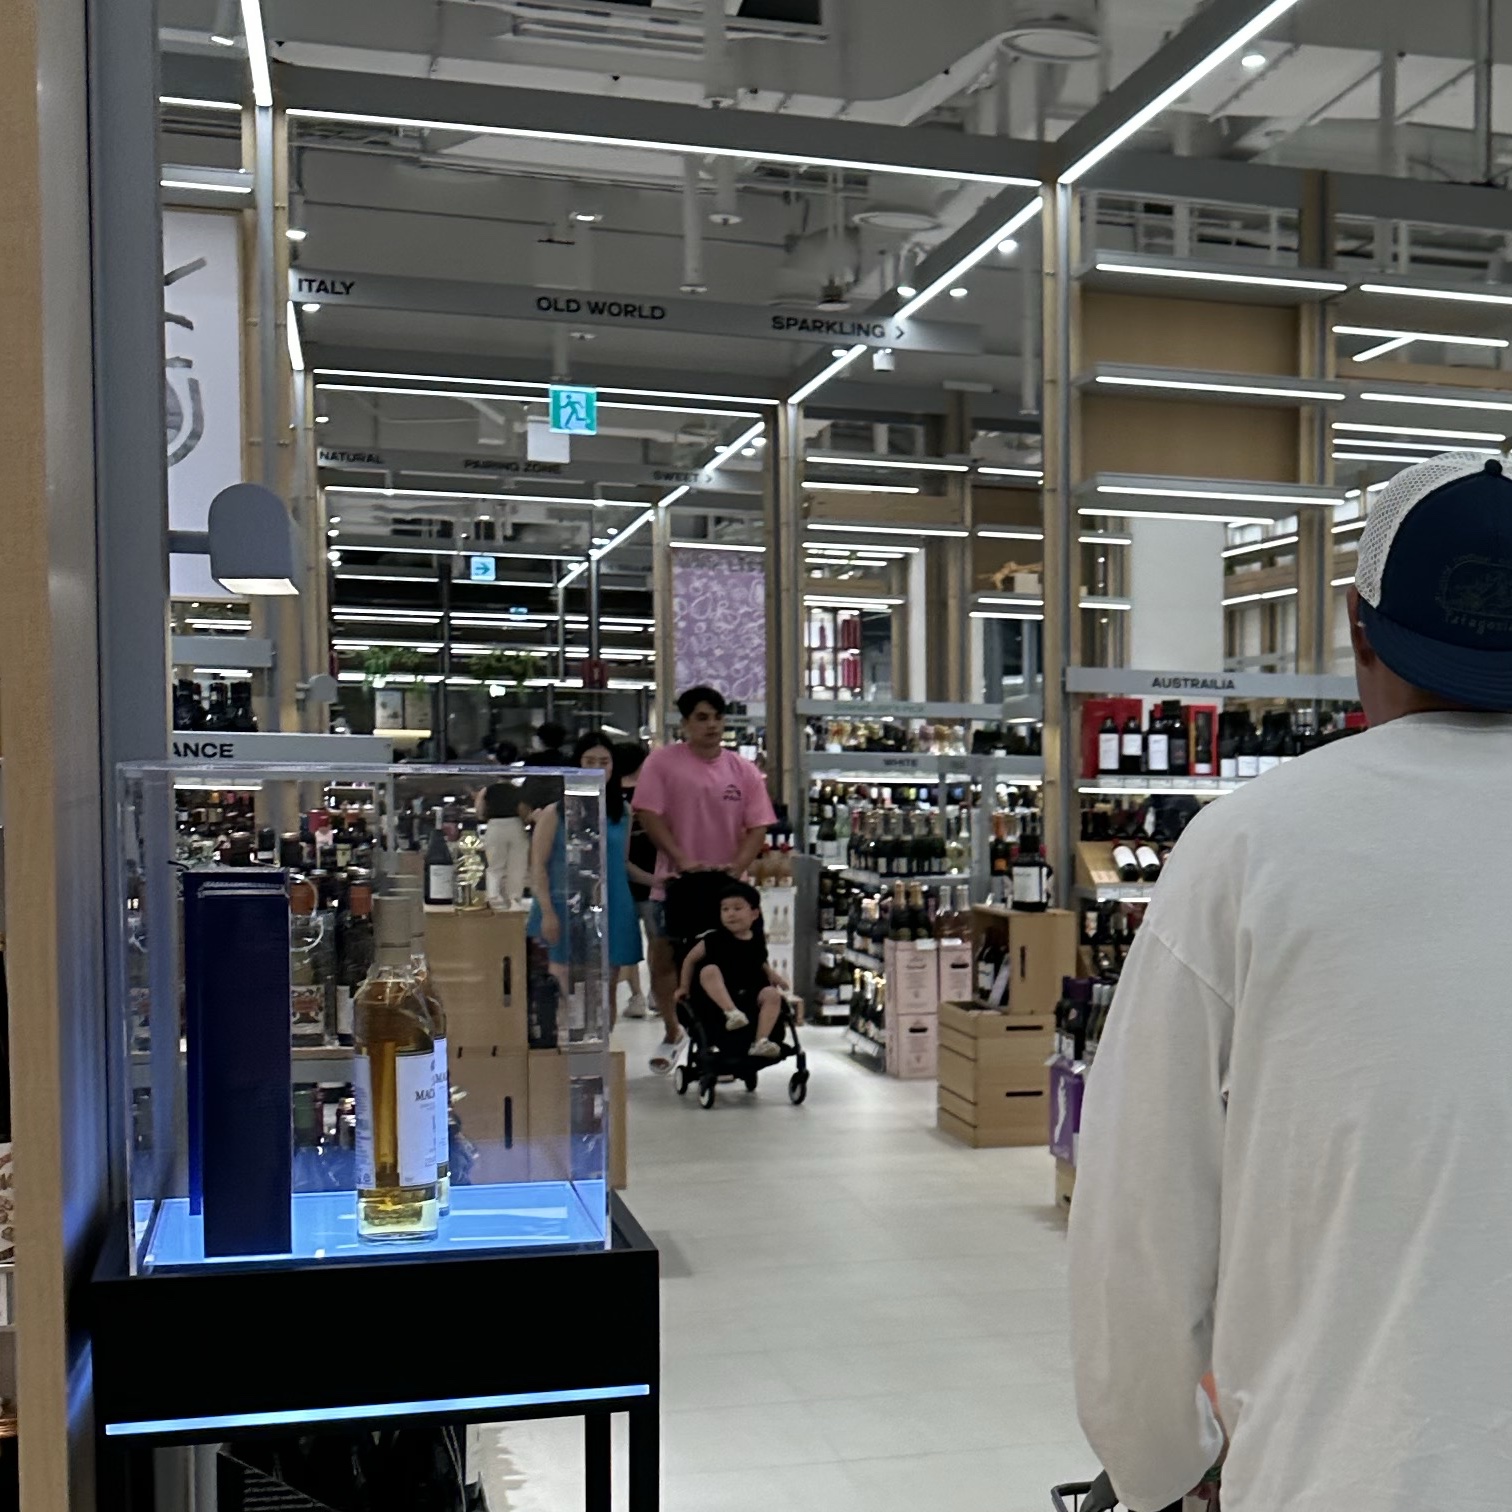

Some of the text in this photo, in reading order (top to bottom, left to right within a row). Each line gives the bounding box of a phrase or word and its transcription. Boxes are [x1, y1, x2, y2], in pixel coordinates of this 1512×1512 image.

[297, 277, 355, 295] ITALY
[536, 296, 667, 321] OLD WORLD
[771, 315, 886, 339] SPARKLING
[319, 450, 384, 465] NATURAL
[523, 462, 562, 475] ZONE
[653, 469, 700, 484] SWEET
[1151, 676, 1236, 690] AUSTRAILIA
[882, 757, 919, 768] WHITE
